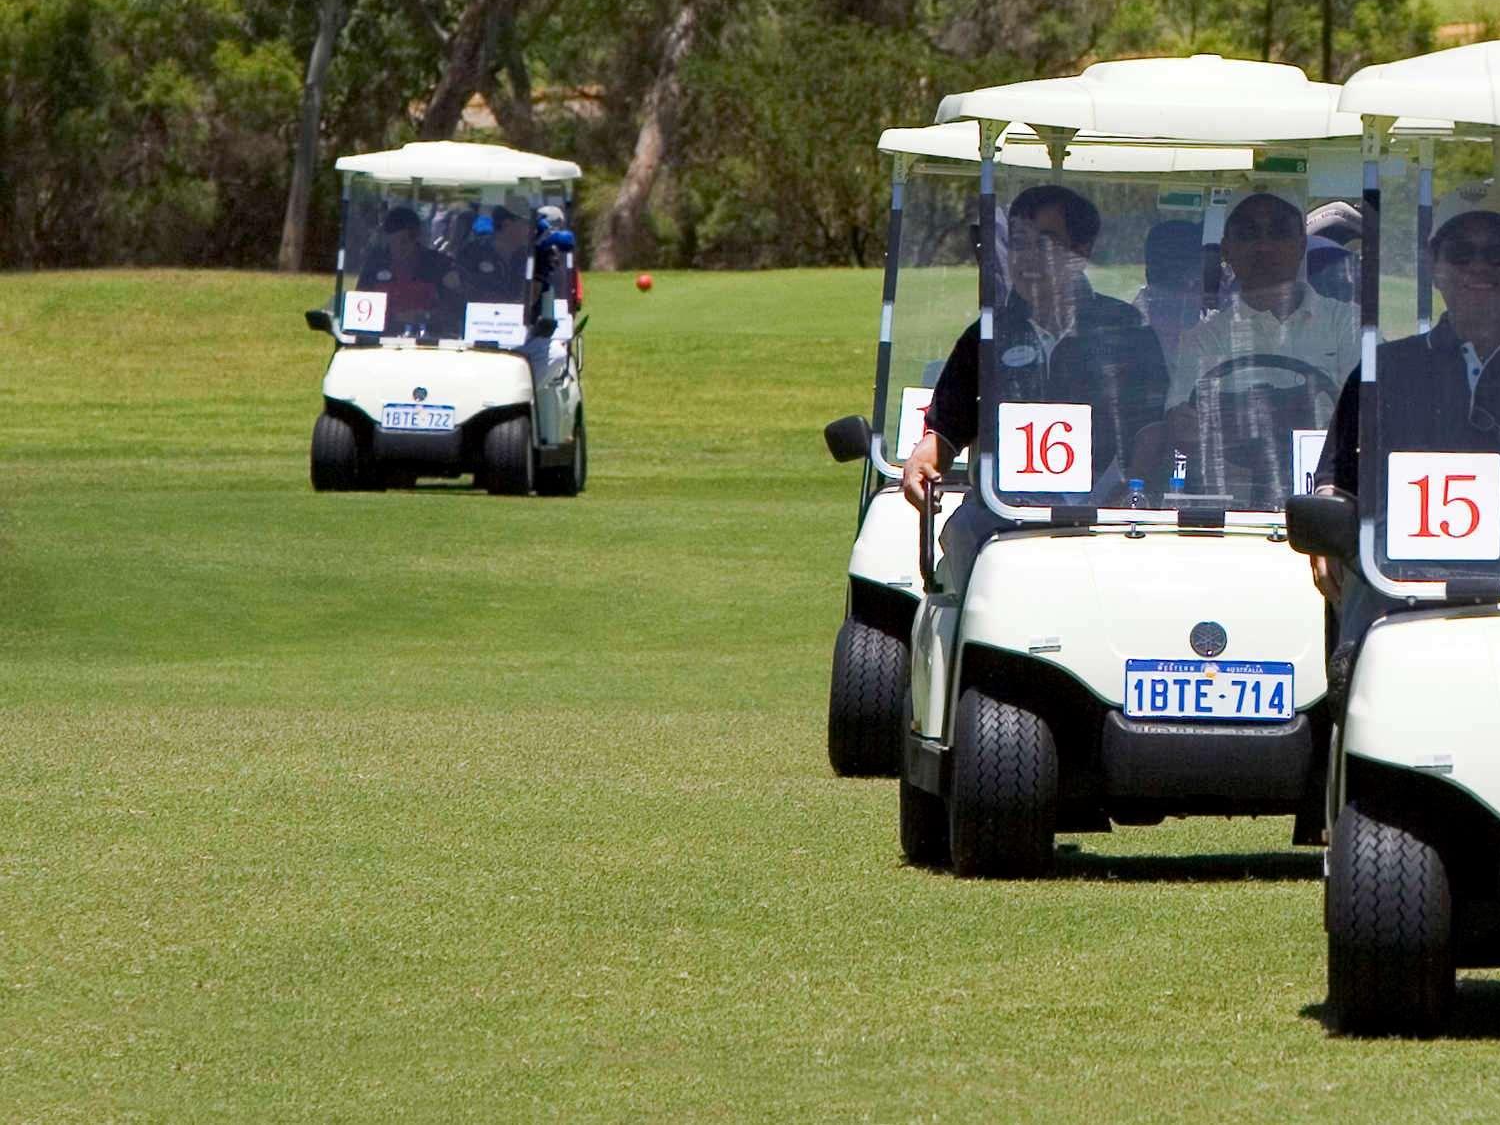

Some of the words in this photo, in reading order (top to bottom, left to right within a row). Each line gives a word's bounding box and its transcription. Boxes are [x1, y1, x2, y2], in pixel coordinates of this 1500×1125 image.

[356, 298, 373, 322] 9
[1016, 421, 1076, 475] 16
[1408, 475, 1481, 538] 15
